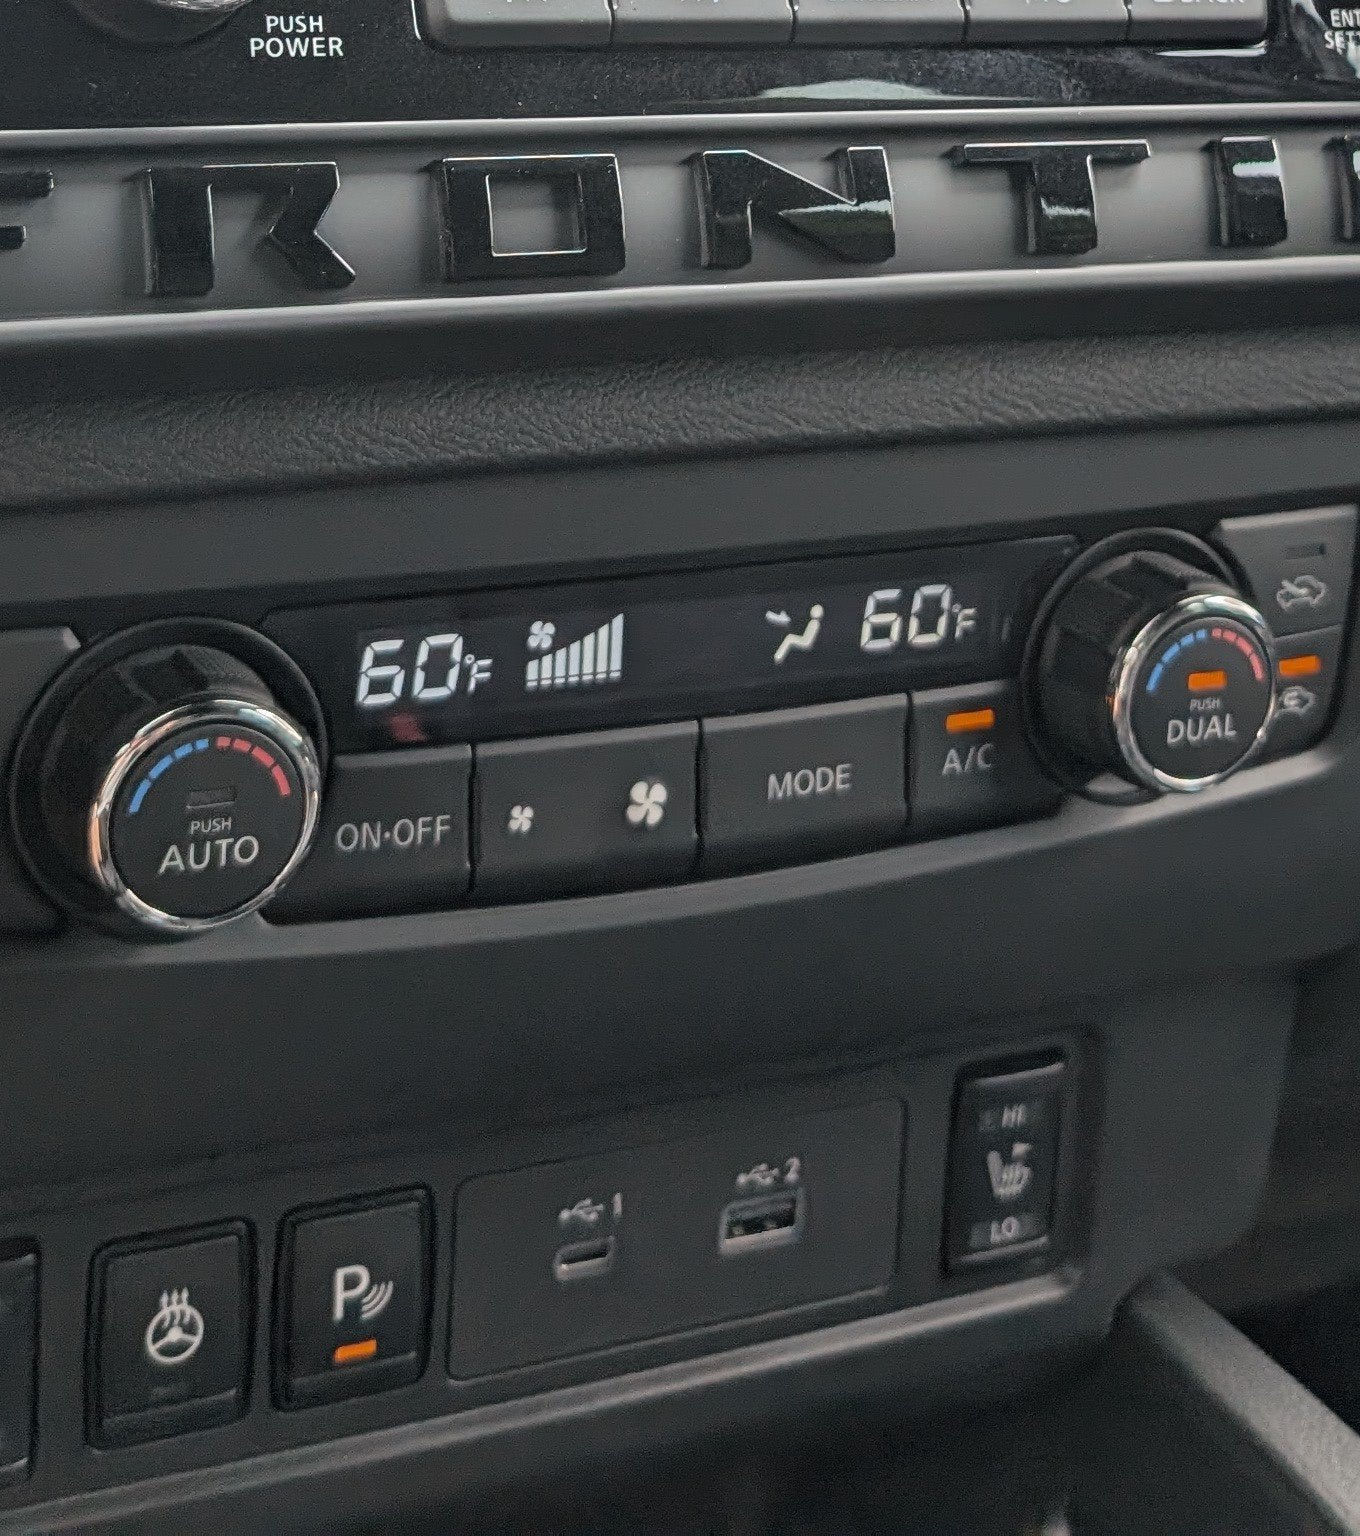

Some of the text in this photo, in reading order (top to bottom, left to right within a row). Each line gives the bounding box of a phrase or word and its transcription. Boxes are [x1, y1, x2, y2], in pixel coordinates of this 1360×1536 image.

[265, 14, 324, 35] PUSH
[249, 36, 344, 58] POWER
[1189, 698, 1221, 711] PUSH
[1166, 717, 1237, 744] DUAL
[942, 744, 993, 776] A/C
[767, 765, 851, 801] MODE
[189, 819, 233, 834] PUSH
[158, 836, 260, 875] AUTO
[990, 1216, 1022, 1243] LO
